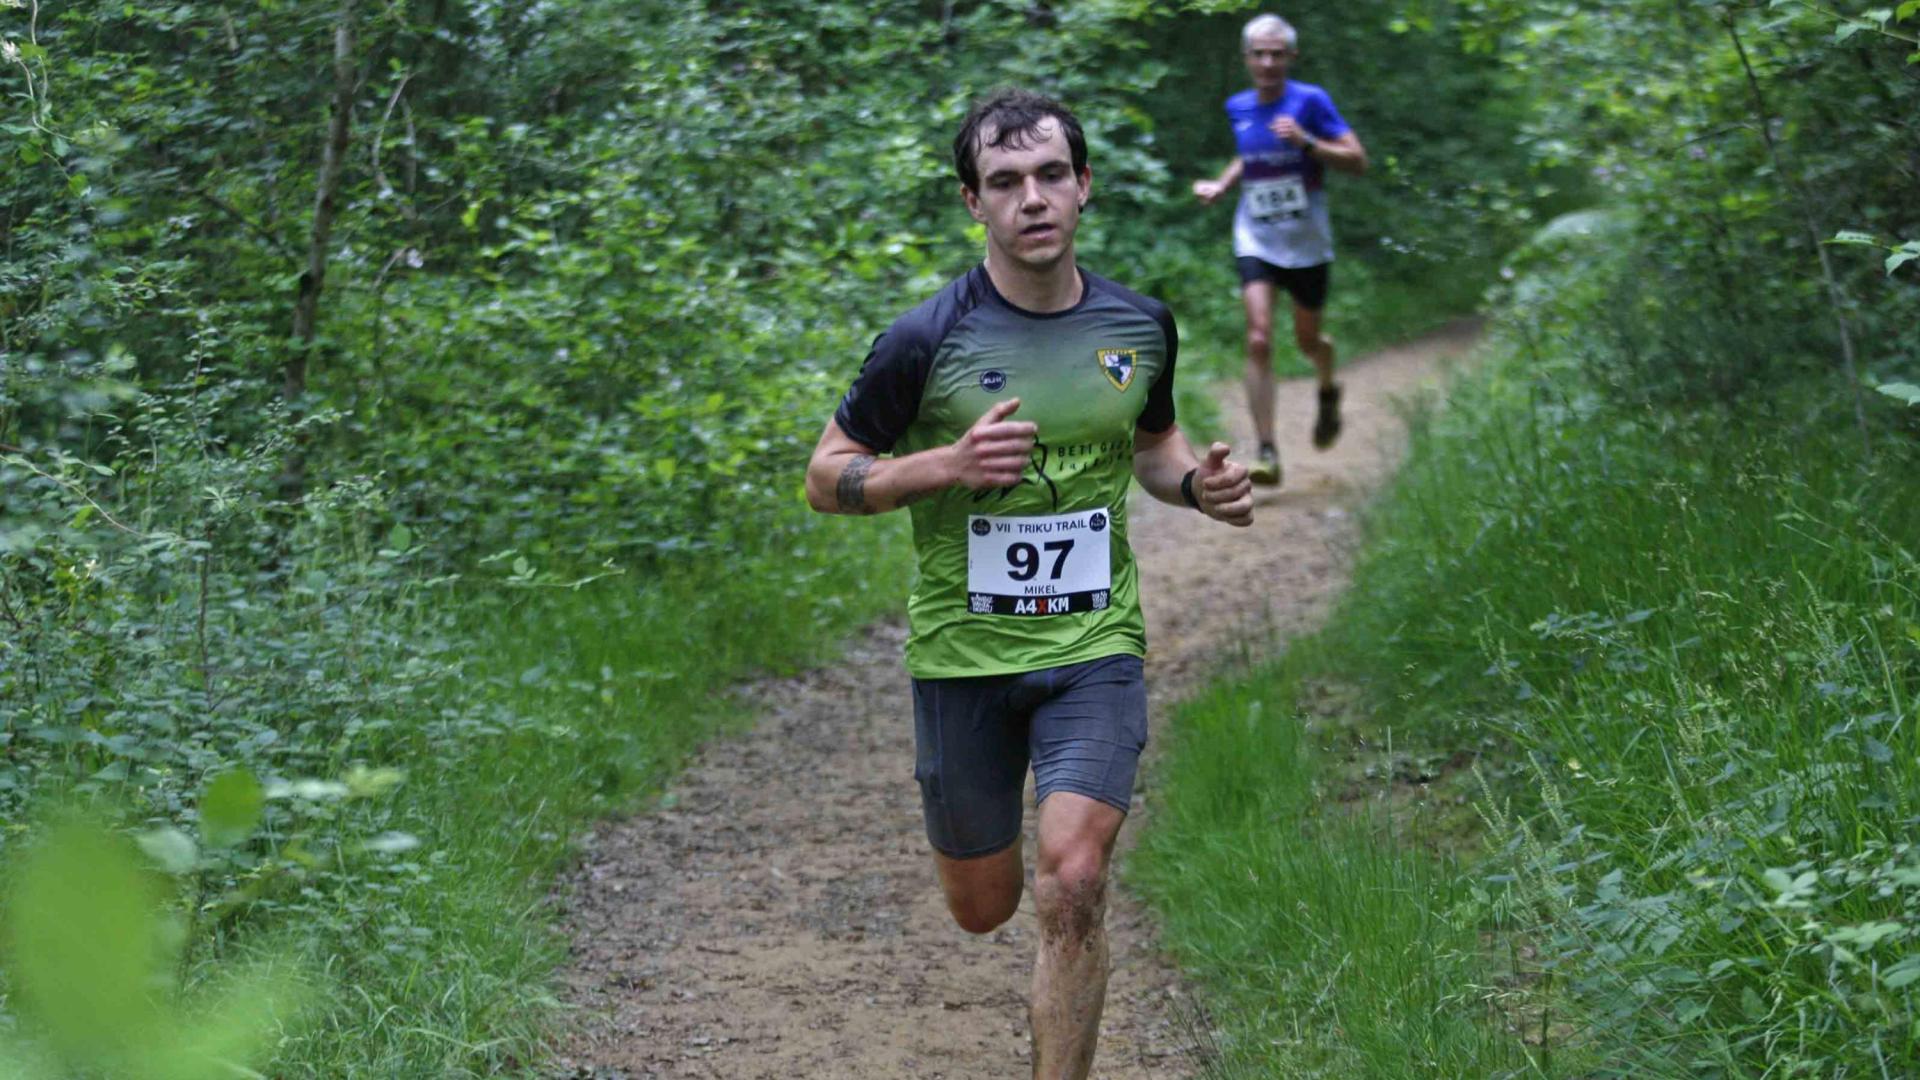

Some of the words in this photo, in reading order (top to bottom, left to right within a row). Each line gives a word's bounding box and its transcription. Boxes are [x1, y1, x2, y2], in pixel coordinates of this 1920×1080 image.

[1057, 443, 1092, 458] BETI
[996, 523, 1011, 533] VII
[1018, 522, 1052, 534] TRIKU
[1056, 519, 1088, 532] TRAIL
[1006, 539, 1075, 582] 97
[1024, 585, 1058, 595] MIKEL
[1014, 596, 1070, 614] A4XKM
